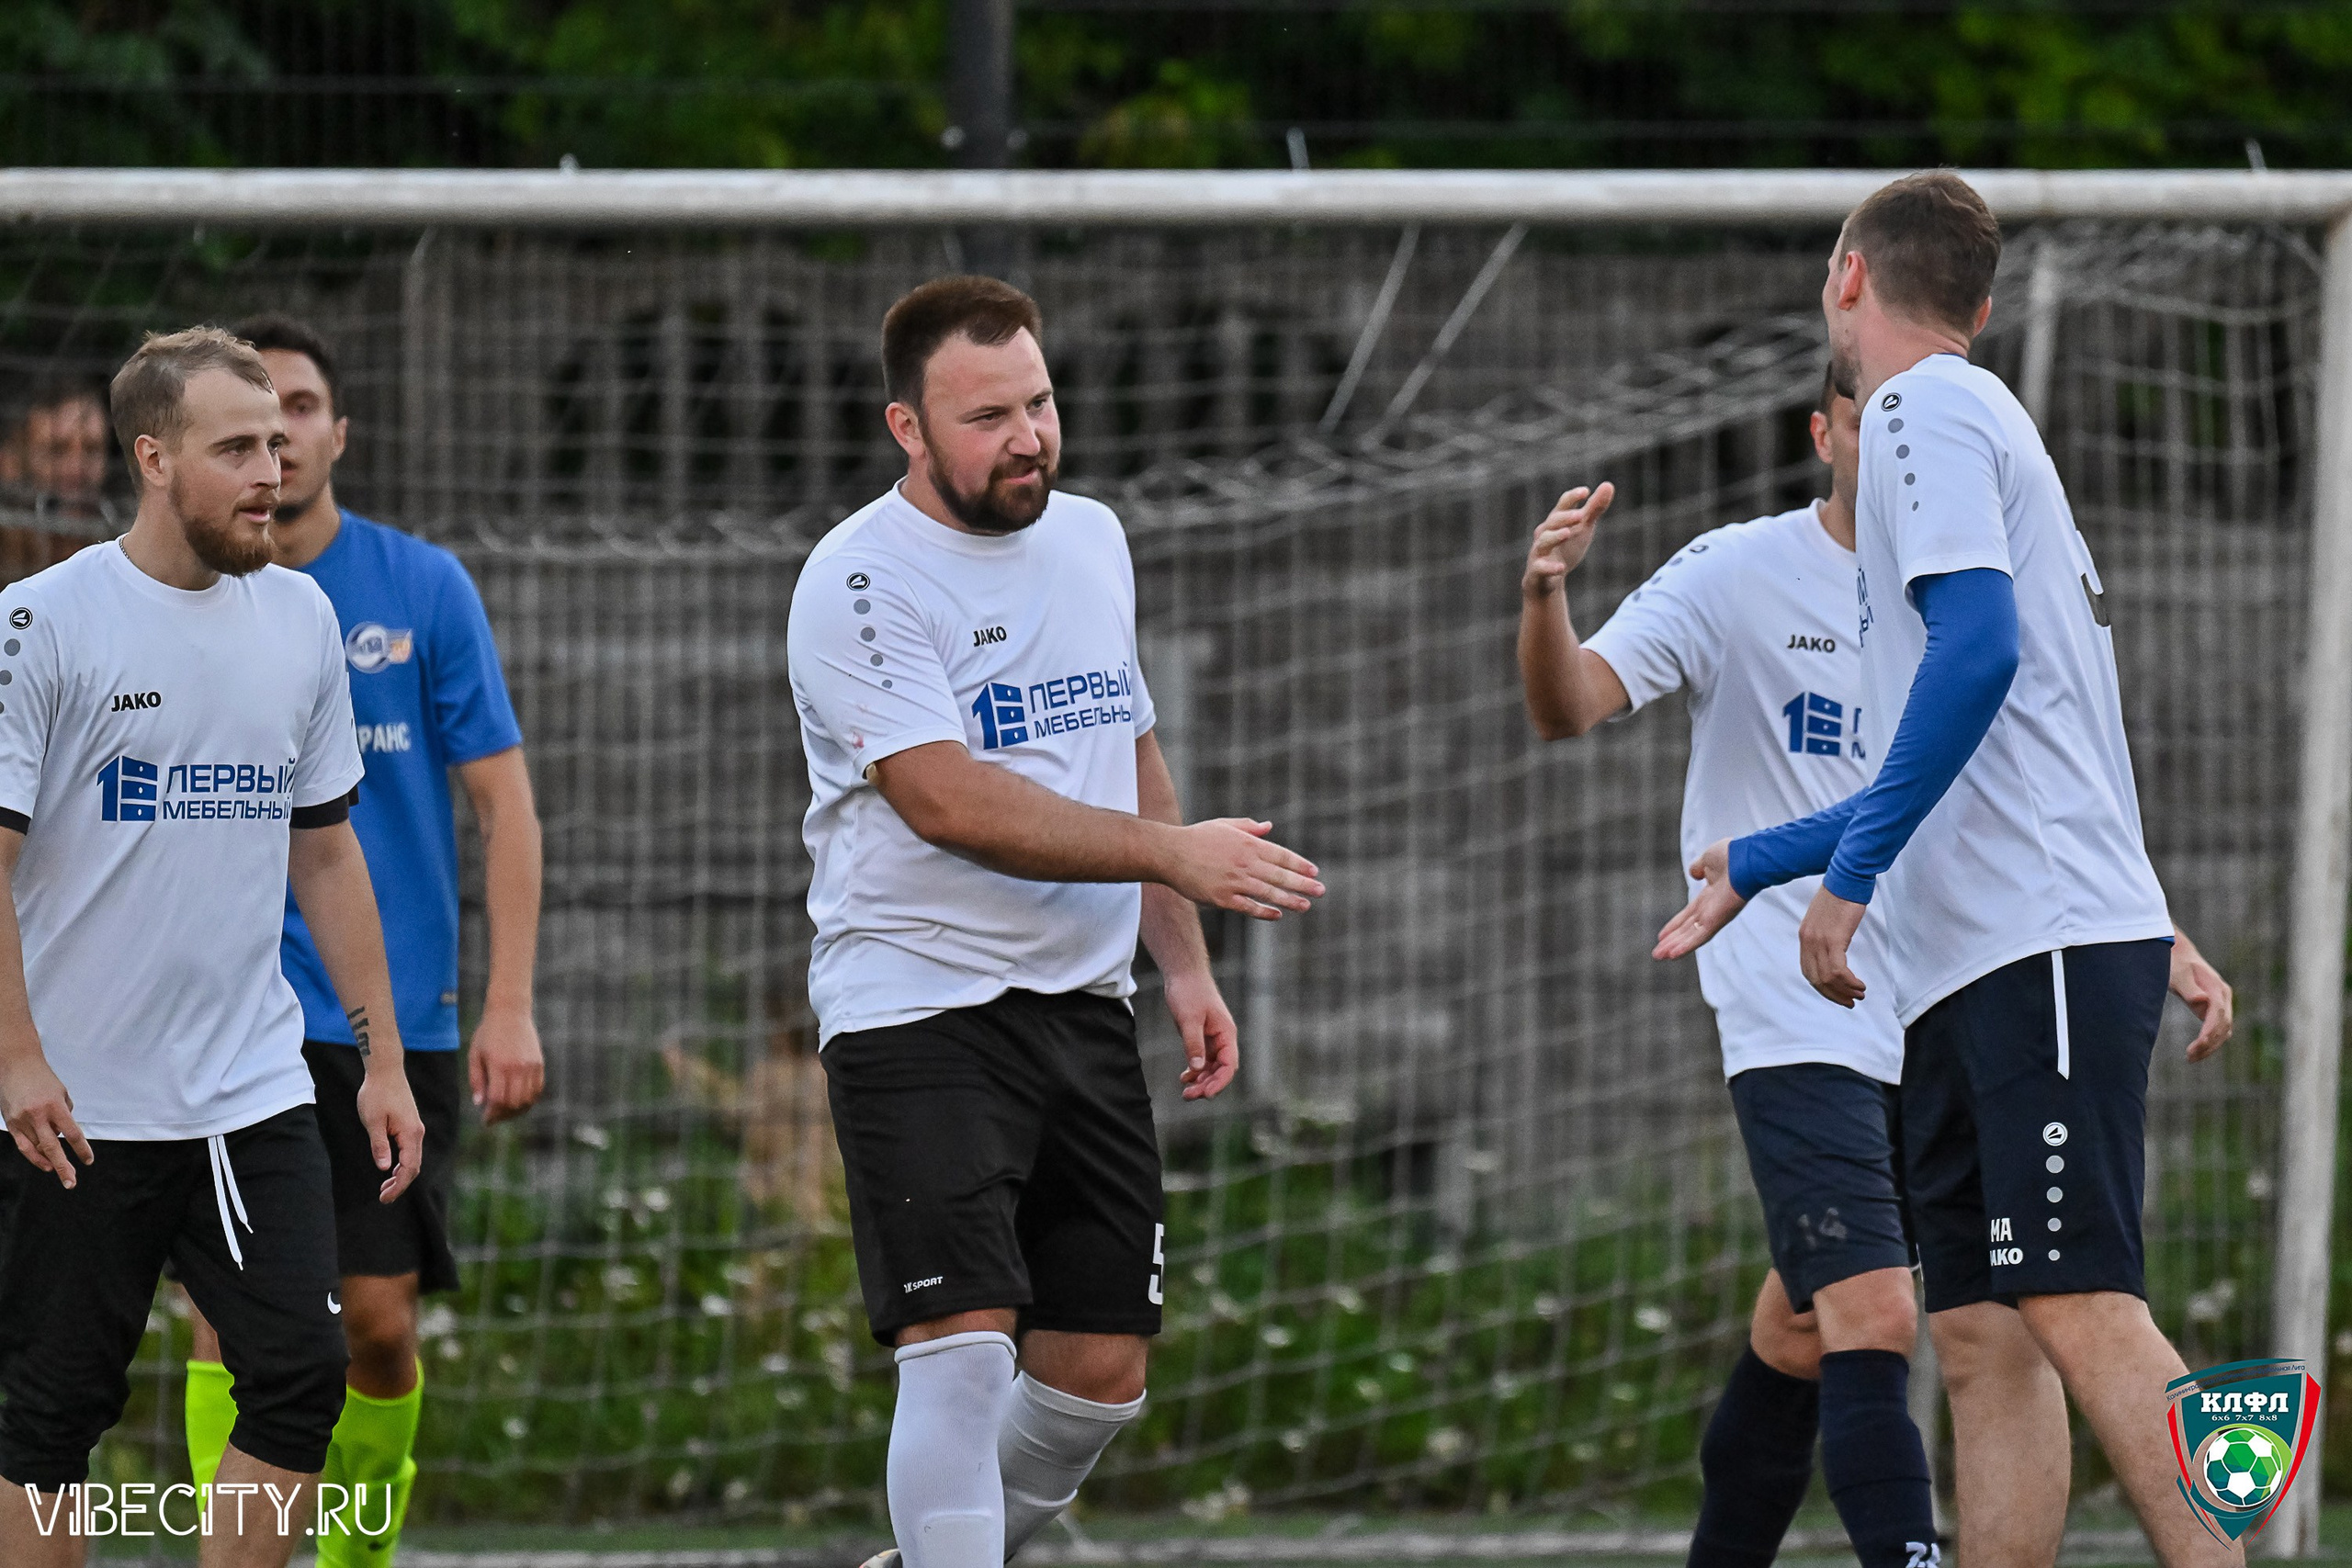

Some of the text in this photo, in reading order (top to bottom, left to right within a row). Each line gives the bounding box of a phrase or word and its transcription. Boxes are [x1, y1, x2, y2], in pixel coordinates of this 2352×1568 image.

[973, 626, 1007, 648] JAKO
[1787, 634, 1836, 653] JAKO
[111, 691, 162, 712] JAKO
[356, 722, 411, 753] РАНС
[1989, 1247, 2024, 1267] AKO
